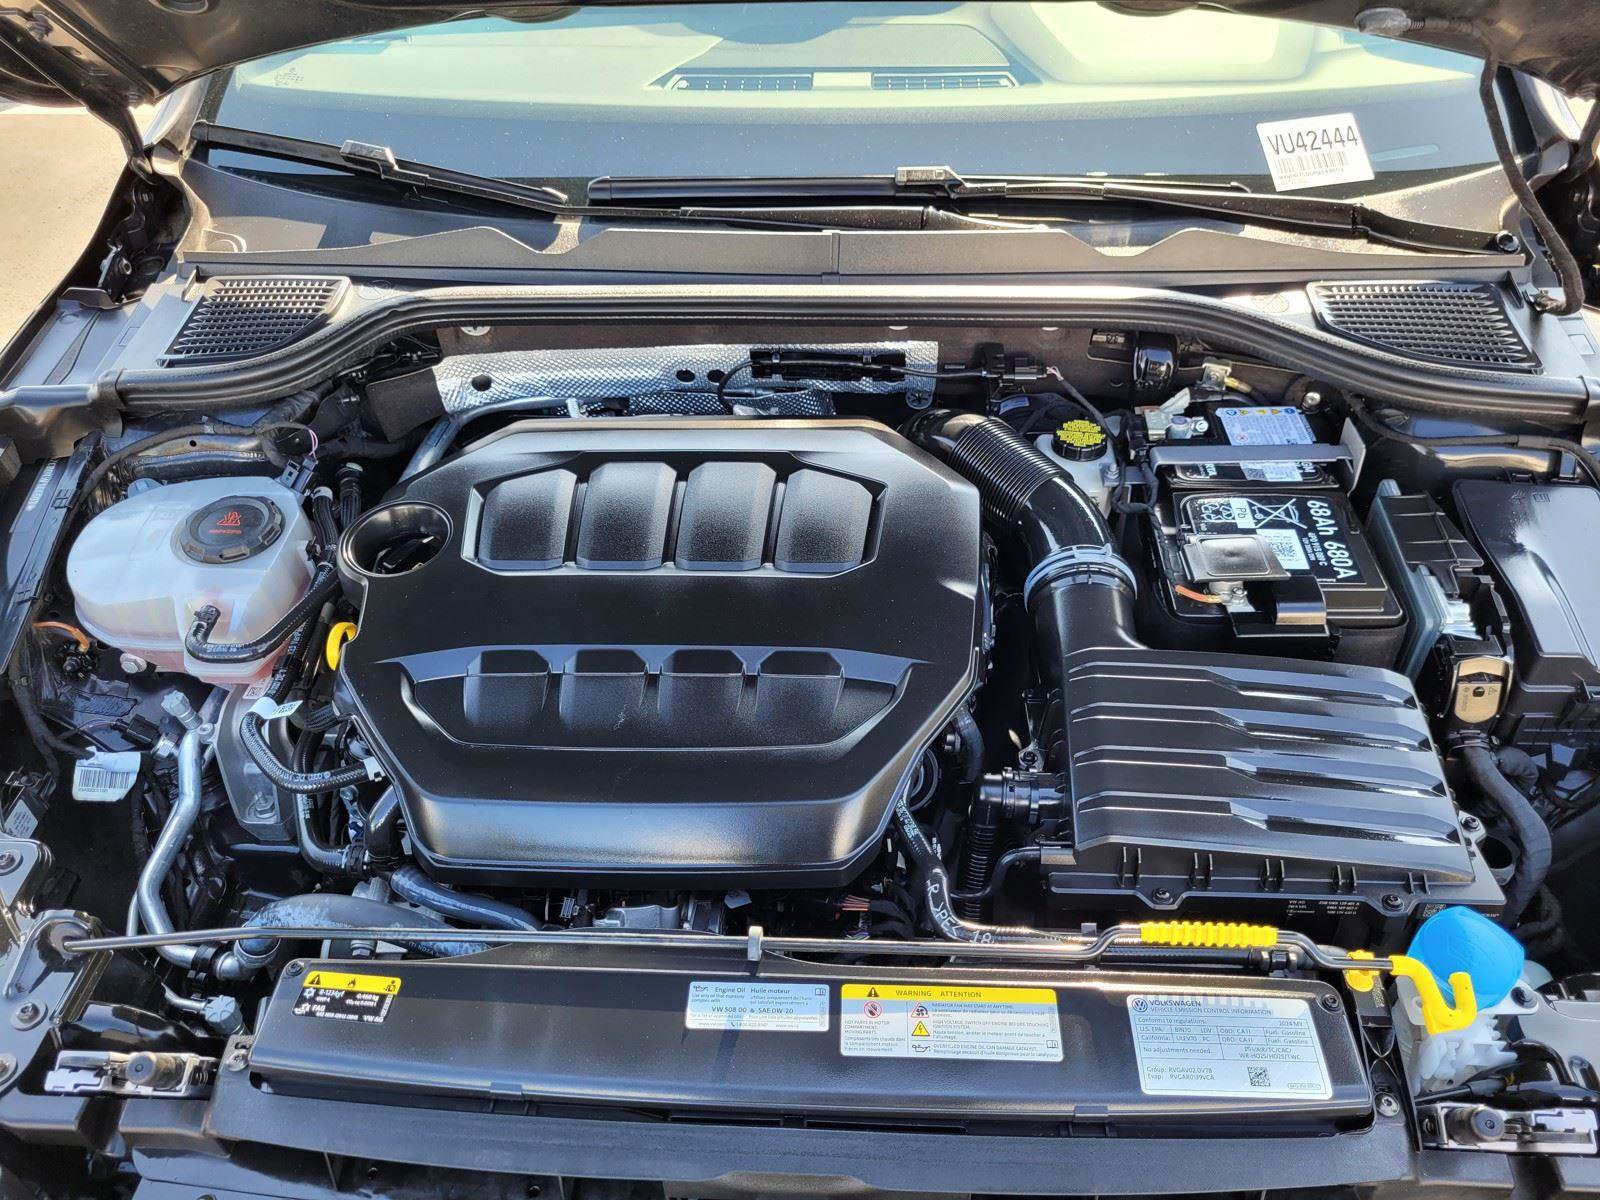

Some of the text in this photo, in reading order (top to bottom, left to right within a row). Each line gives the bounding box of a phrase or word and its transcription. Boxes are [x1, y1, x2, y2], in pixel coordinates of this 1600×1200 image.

[1267, 125, 1358, 155] VU42444
[1235, 507, 1247, 518] Pb
[1307, 500, 1338, 535] 68Ah
[1323, 541, 1358, 579] 680A
[318, 989, 345, 998] R-1234yf
[715, 986, 735, 994] Engine
[1149, 999, 1201, 1007] VOLKSWAGEN
